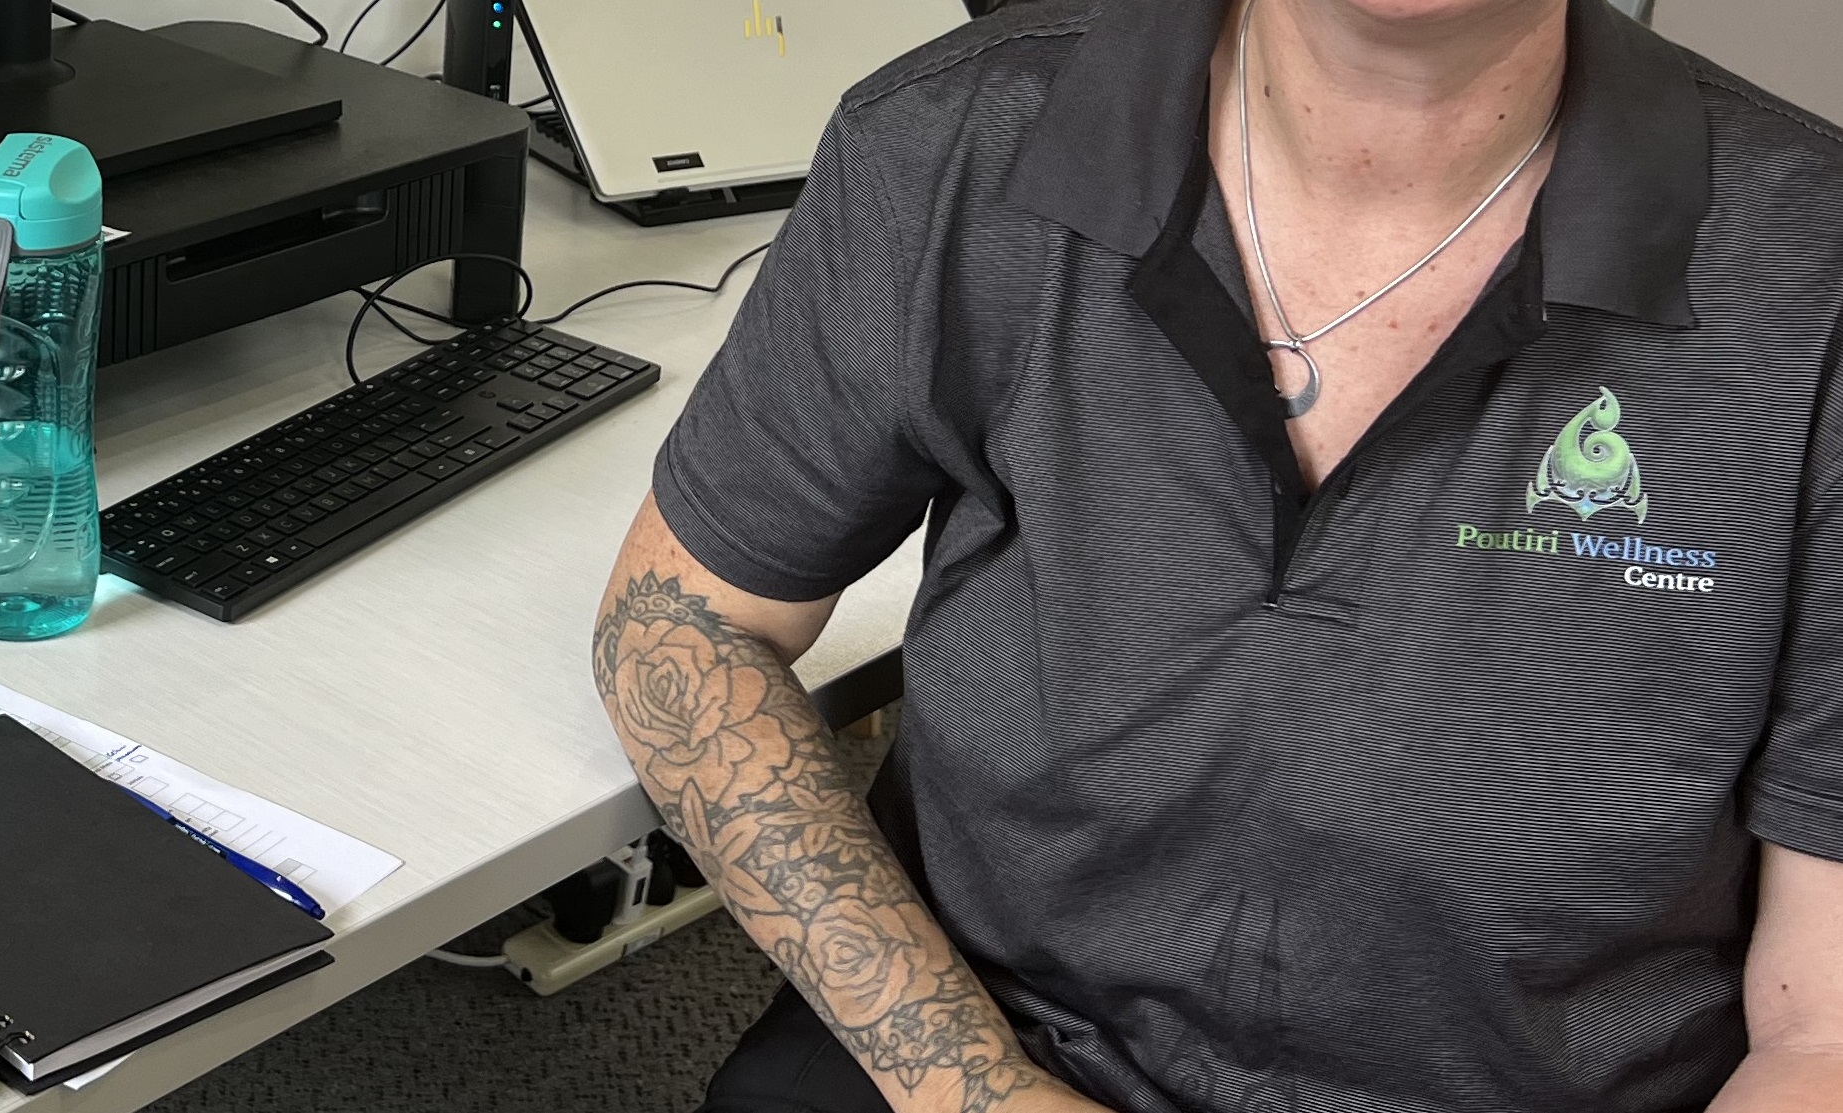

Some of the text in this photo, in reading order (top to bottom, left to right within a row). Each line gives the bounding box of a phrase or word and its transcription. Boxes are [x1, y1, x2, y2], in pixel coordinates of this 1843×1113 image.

[2, 135, 53, 177] sistema
[236, 544, 249, 552] Z
[1456, 523, 1717, 568] Poutiri Wellness
[1624, 566, 1715, 592] Centre
